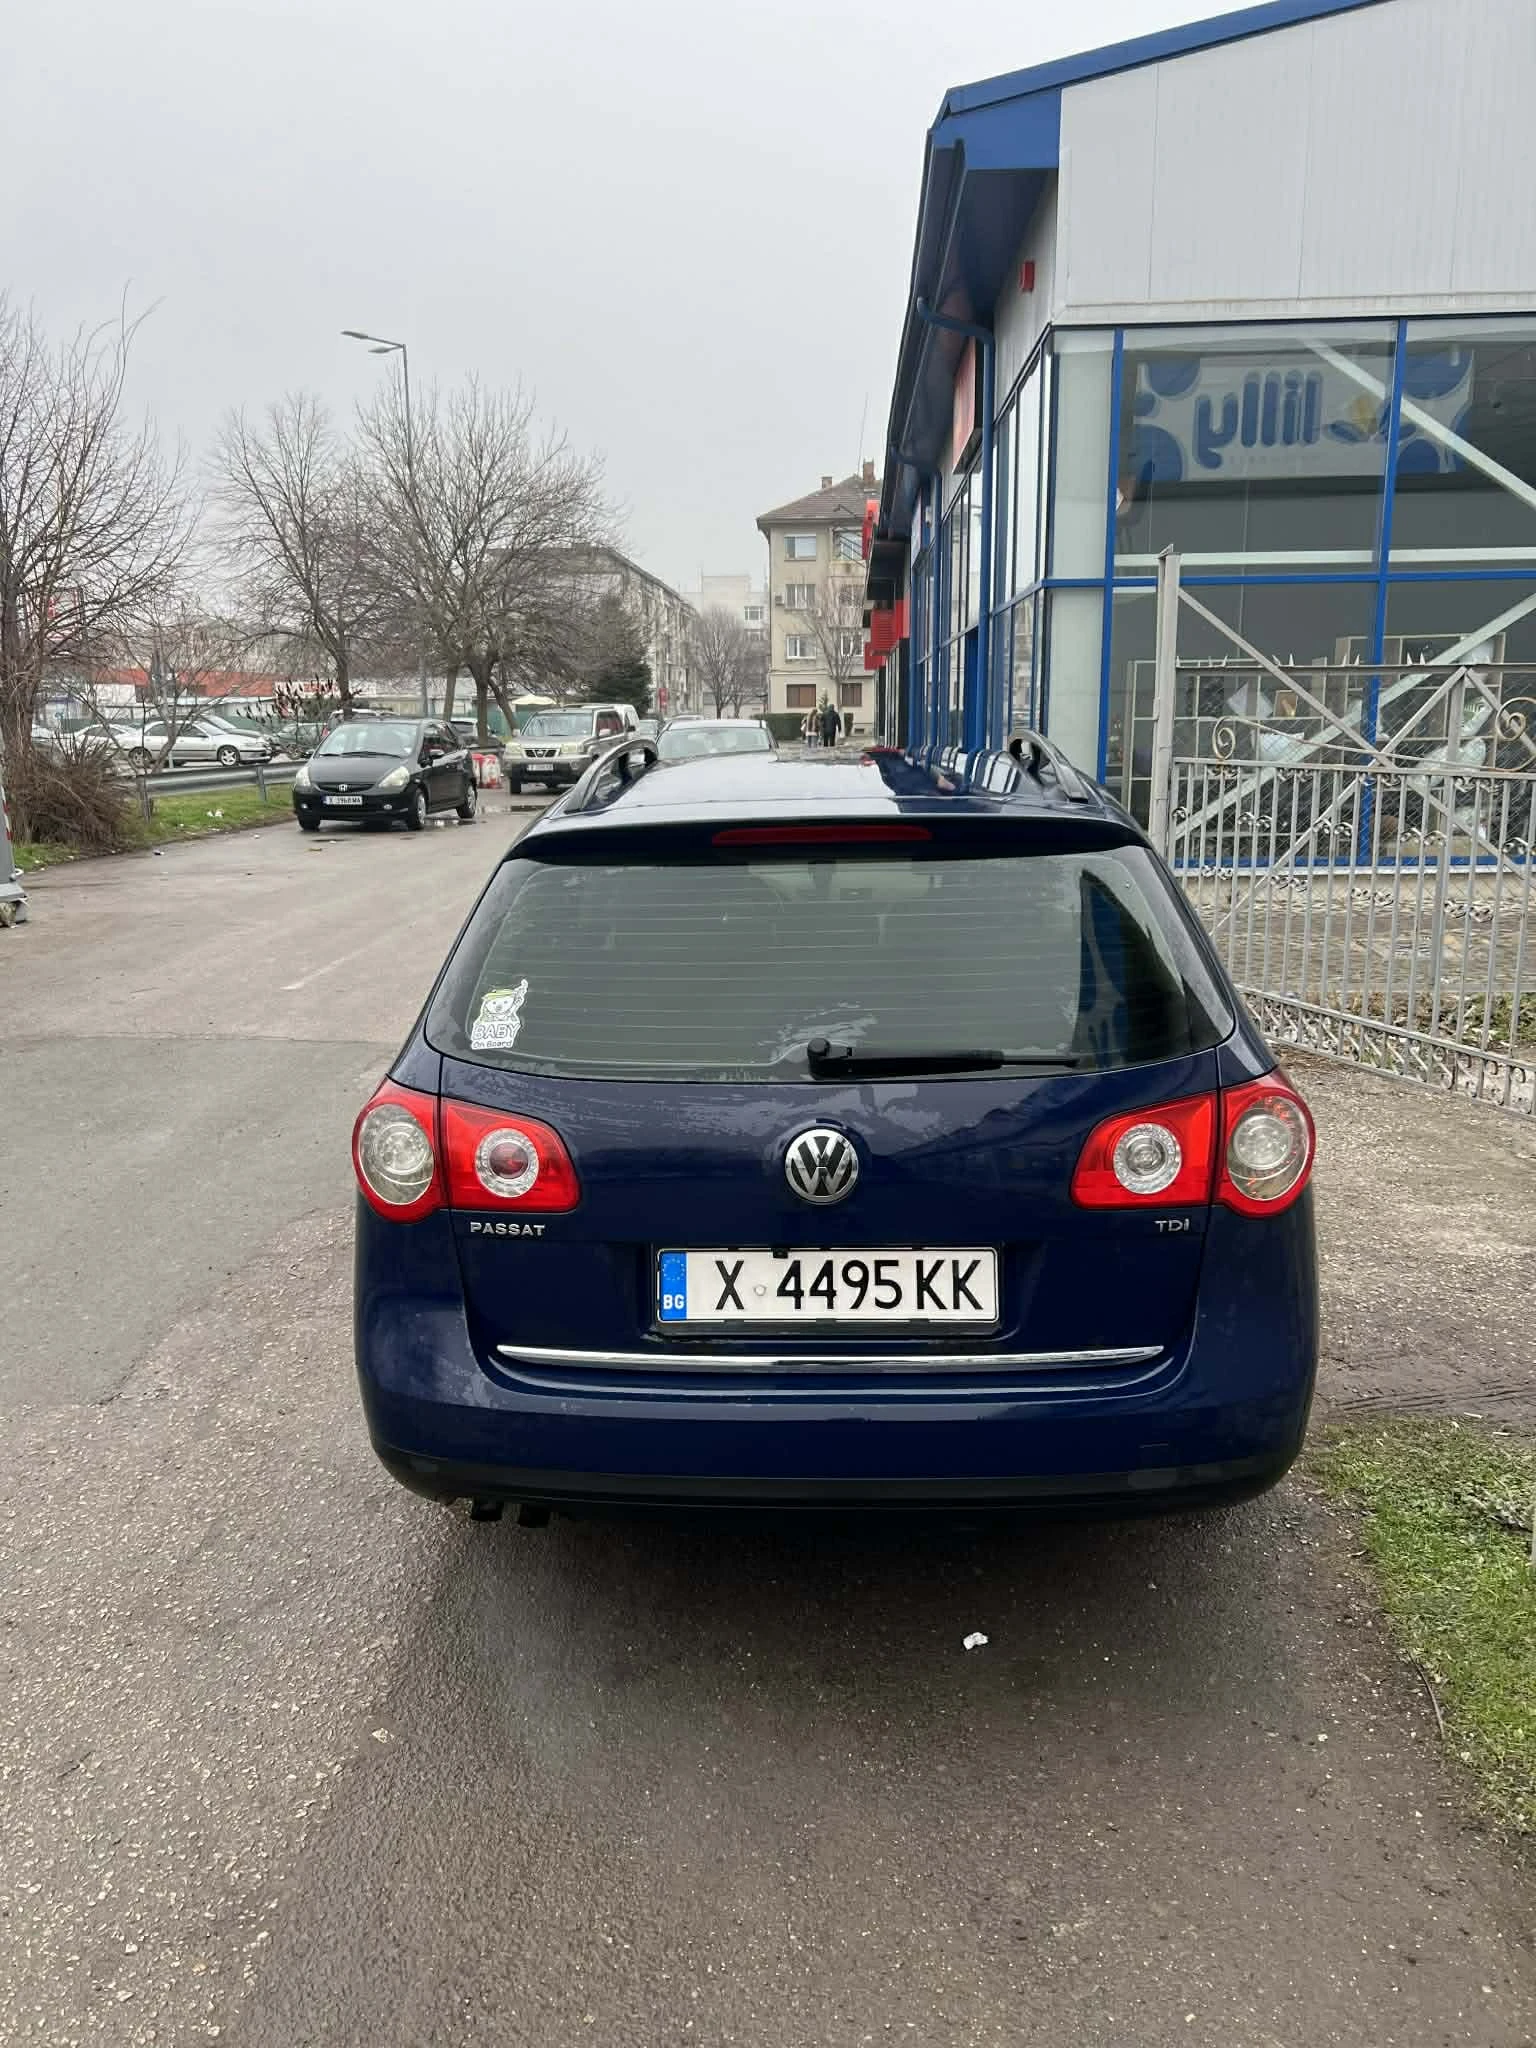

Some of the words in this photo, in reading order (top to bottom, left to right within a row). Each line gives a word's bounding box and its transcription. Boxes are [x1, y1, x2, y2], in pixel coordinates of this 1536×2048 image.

[473, 1023, 520, 1039] BABY
[470, 1221, 545, 1236] PASSAT
[715, 1260, 745, 1310] X
[662, 1293, 685, 1309] BG
